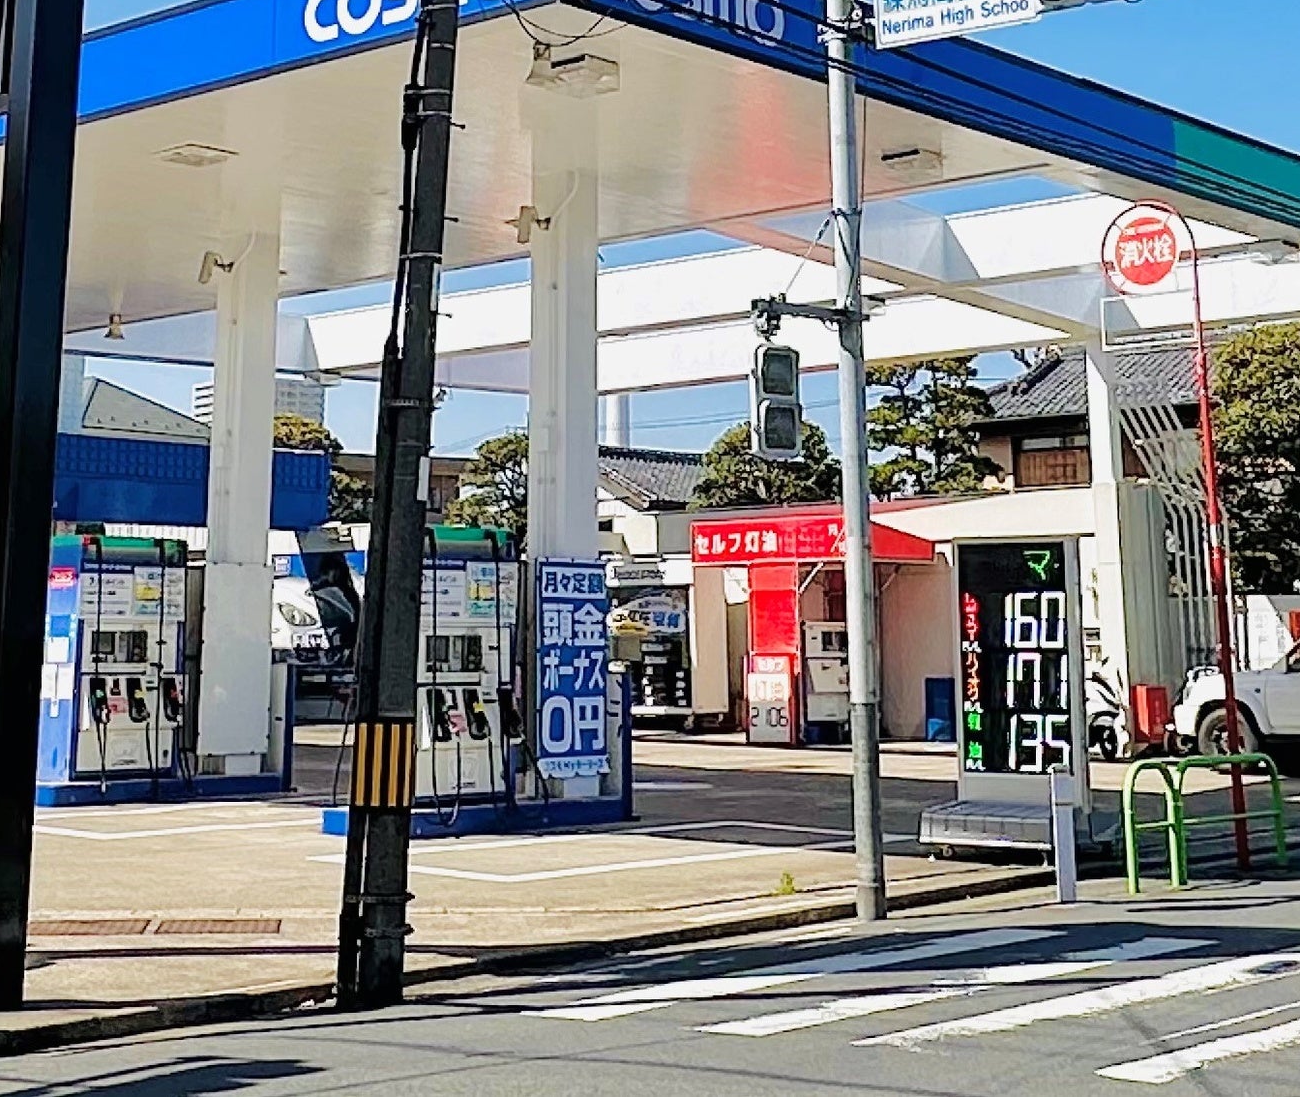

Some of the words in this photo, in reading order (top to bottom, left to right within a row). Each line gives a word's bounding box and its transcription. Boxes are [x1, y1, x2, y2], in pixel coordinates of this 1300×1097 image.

[882, 15, 935, 36] Nerima
[940, 5, 975, 26] High
[1119, 235, 1175, 269] 消火栓
[694, 529, 778, 554] セルフ灯油
[542, 602, 605, 646] 頭金
[1004, 590, 1066, 649] 160
[543, 649, 605, 691] ボーナス
[1006, 652, 1068, 709] 171
[541, 694, 605, 754] 0円
[1007, 713, 1072, 772] 135
